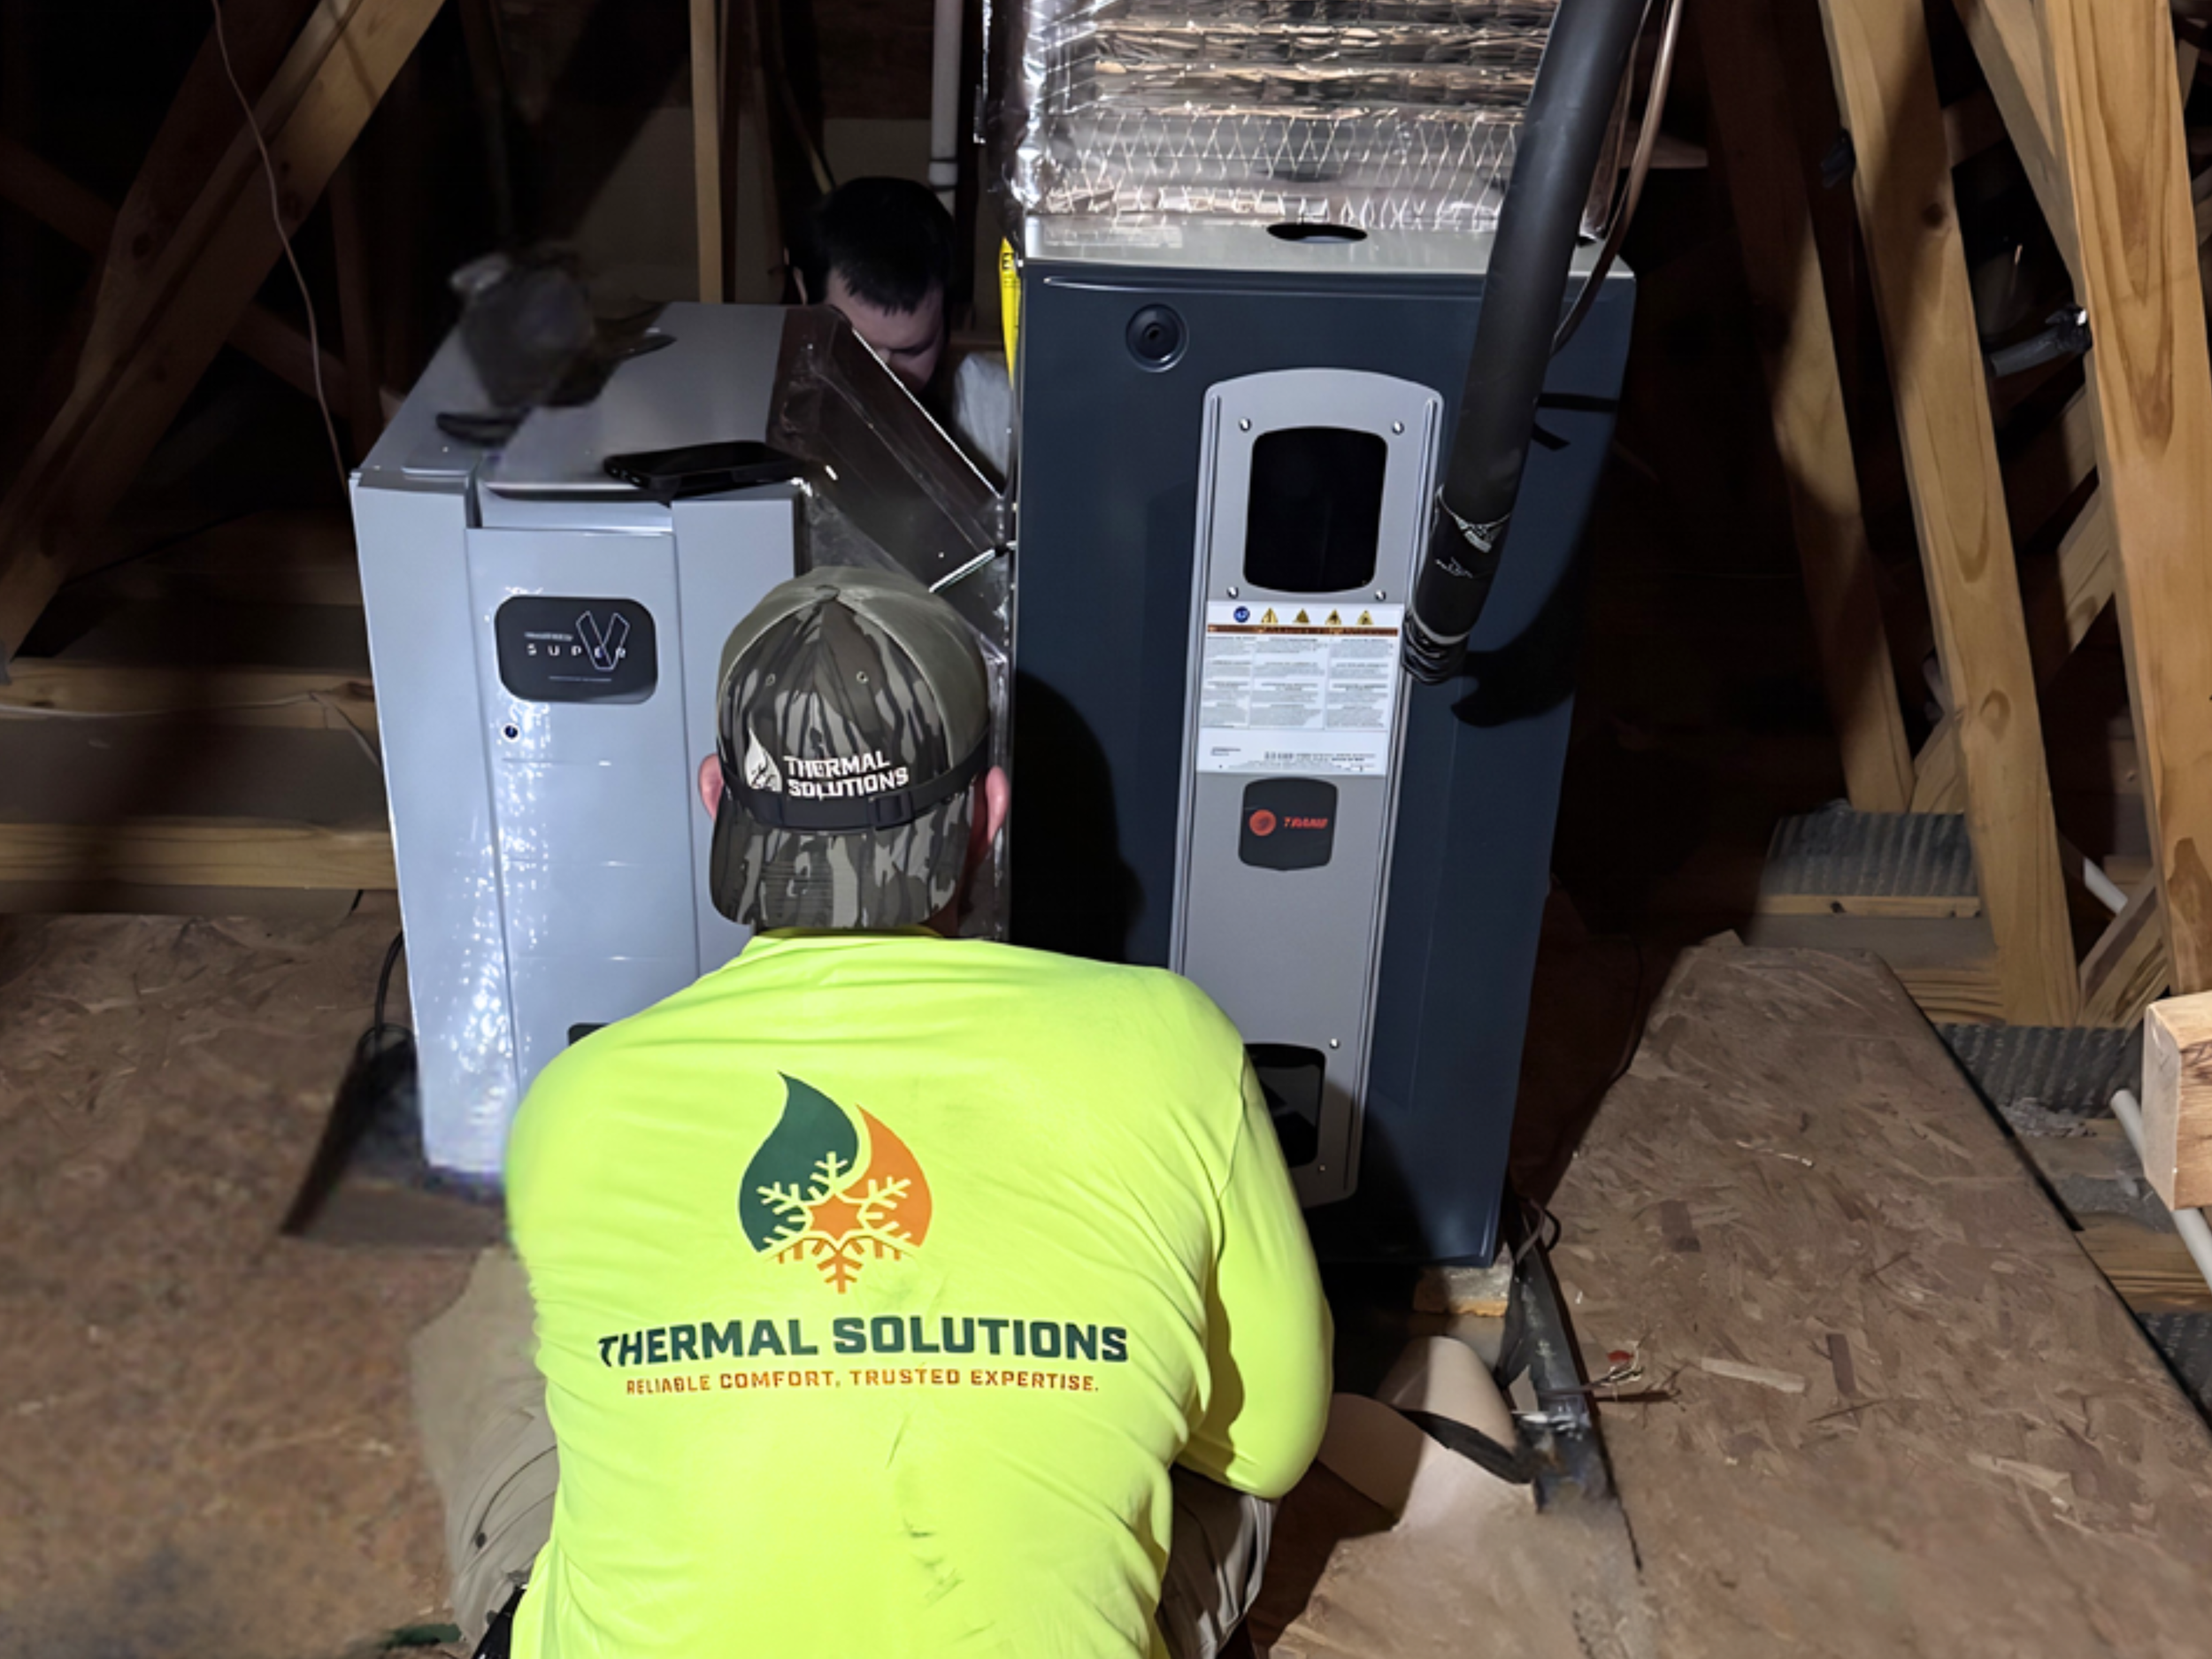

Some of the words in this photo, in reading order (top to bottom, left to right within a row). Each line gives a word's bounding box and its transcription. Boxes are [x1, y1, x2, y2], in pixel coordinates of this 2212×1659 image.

[783, 751, 890, 779] THERMAL
[787, 767, 909, 800] SOLUTIONS
[598, 1319, 818, 1367] THERMAL
[833, 1316, 1129, 1363] SOLUTIONS
[626, 1373, 710, 1395] RELIABLE
[720, 1369, 841, 1389] COMFORT,
[849, 1368, 960, 1386] TRUSTED
[970, 1368, 1100, 1393] EXPERTISE.
